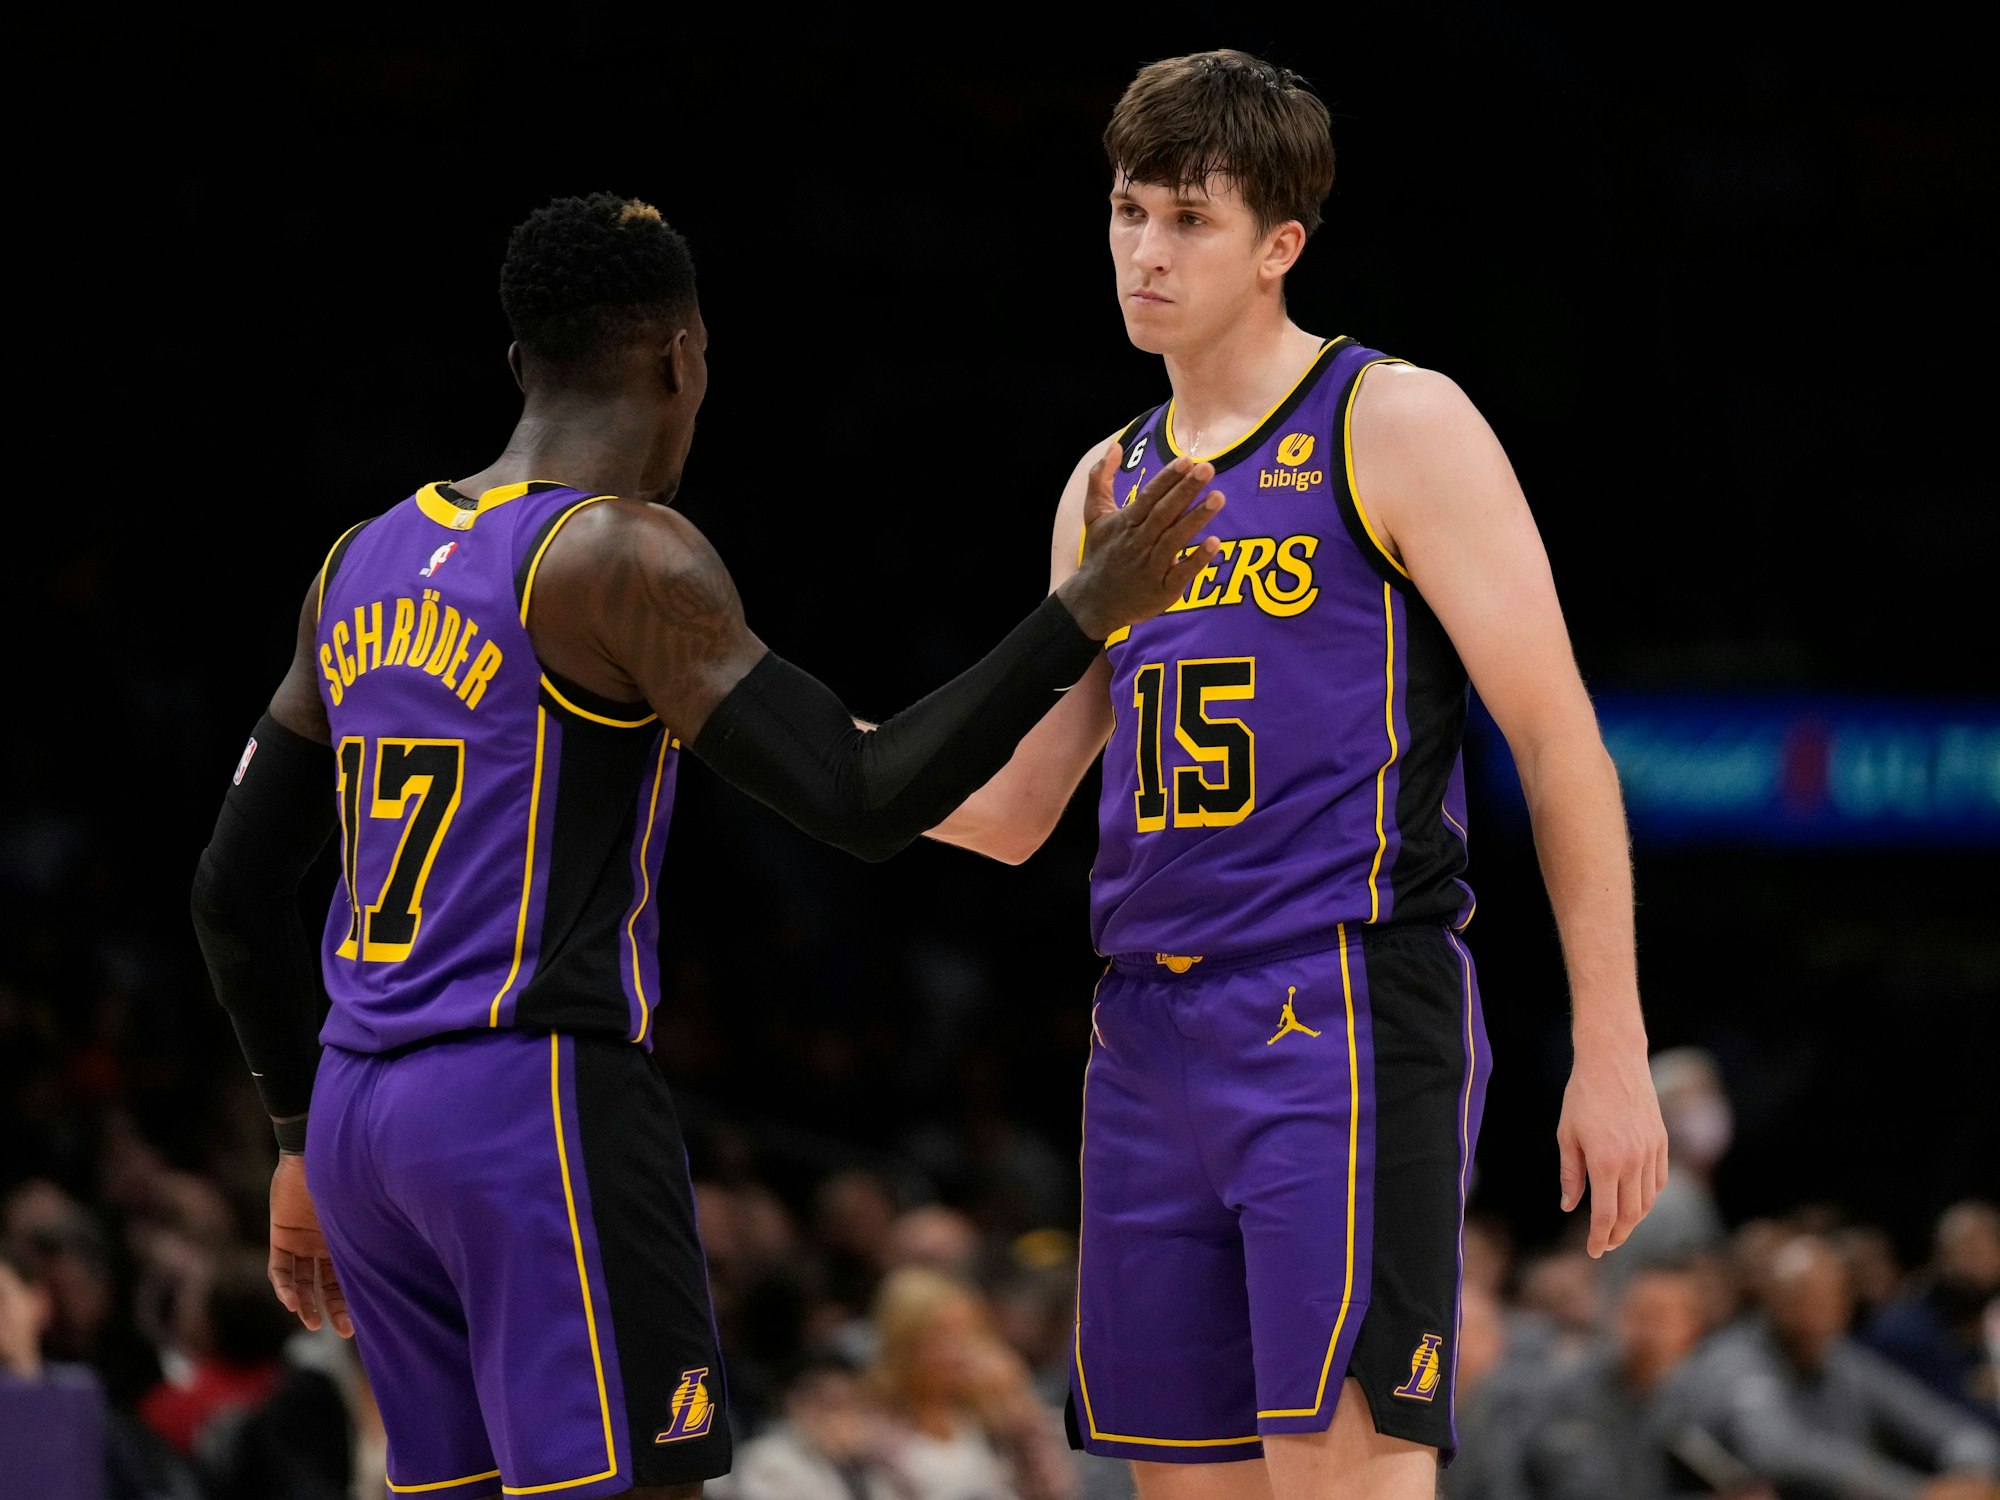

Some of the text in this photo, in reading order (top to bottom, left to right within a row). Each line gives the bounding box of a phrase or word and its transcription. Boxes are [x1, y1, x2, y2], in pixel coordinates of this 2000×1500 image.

[1126, 437, 1148, 469] 6
[1258, 468, 1323, 491] bibigo
[319, 588, 503, 711] SCHRÖDER
[1104, 534, 1321, 650] ERS
[1133, 656, 1255, 833] 15
[335, 736, 466, 962] 17
